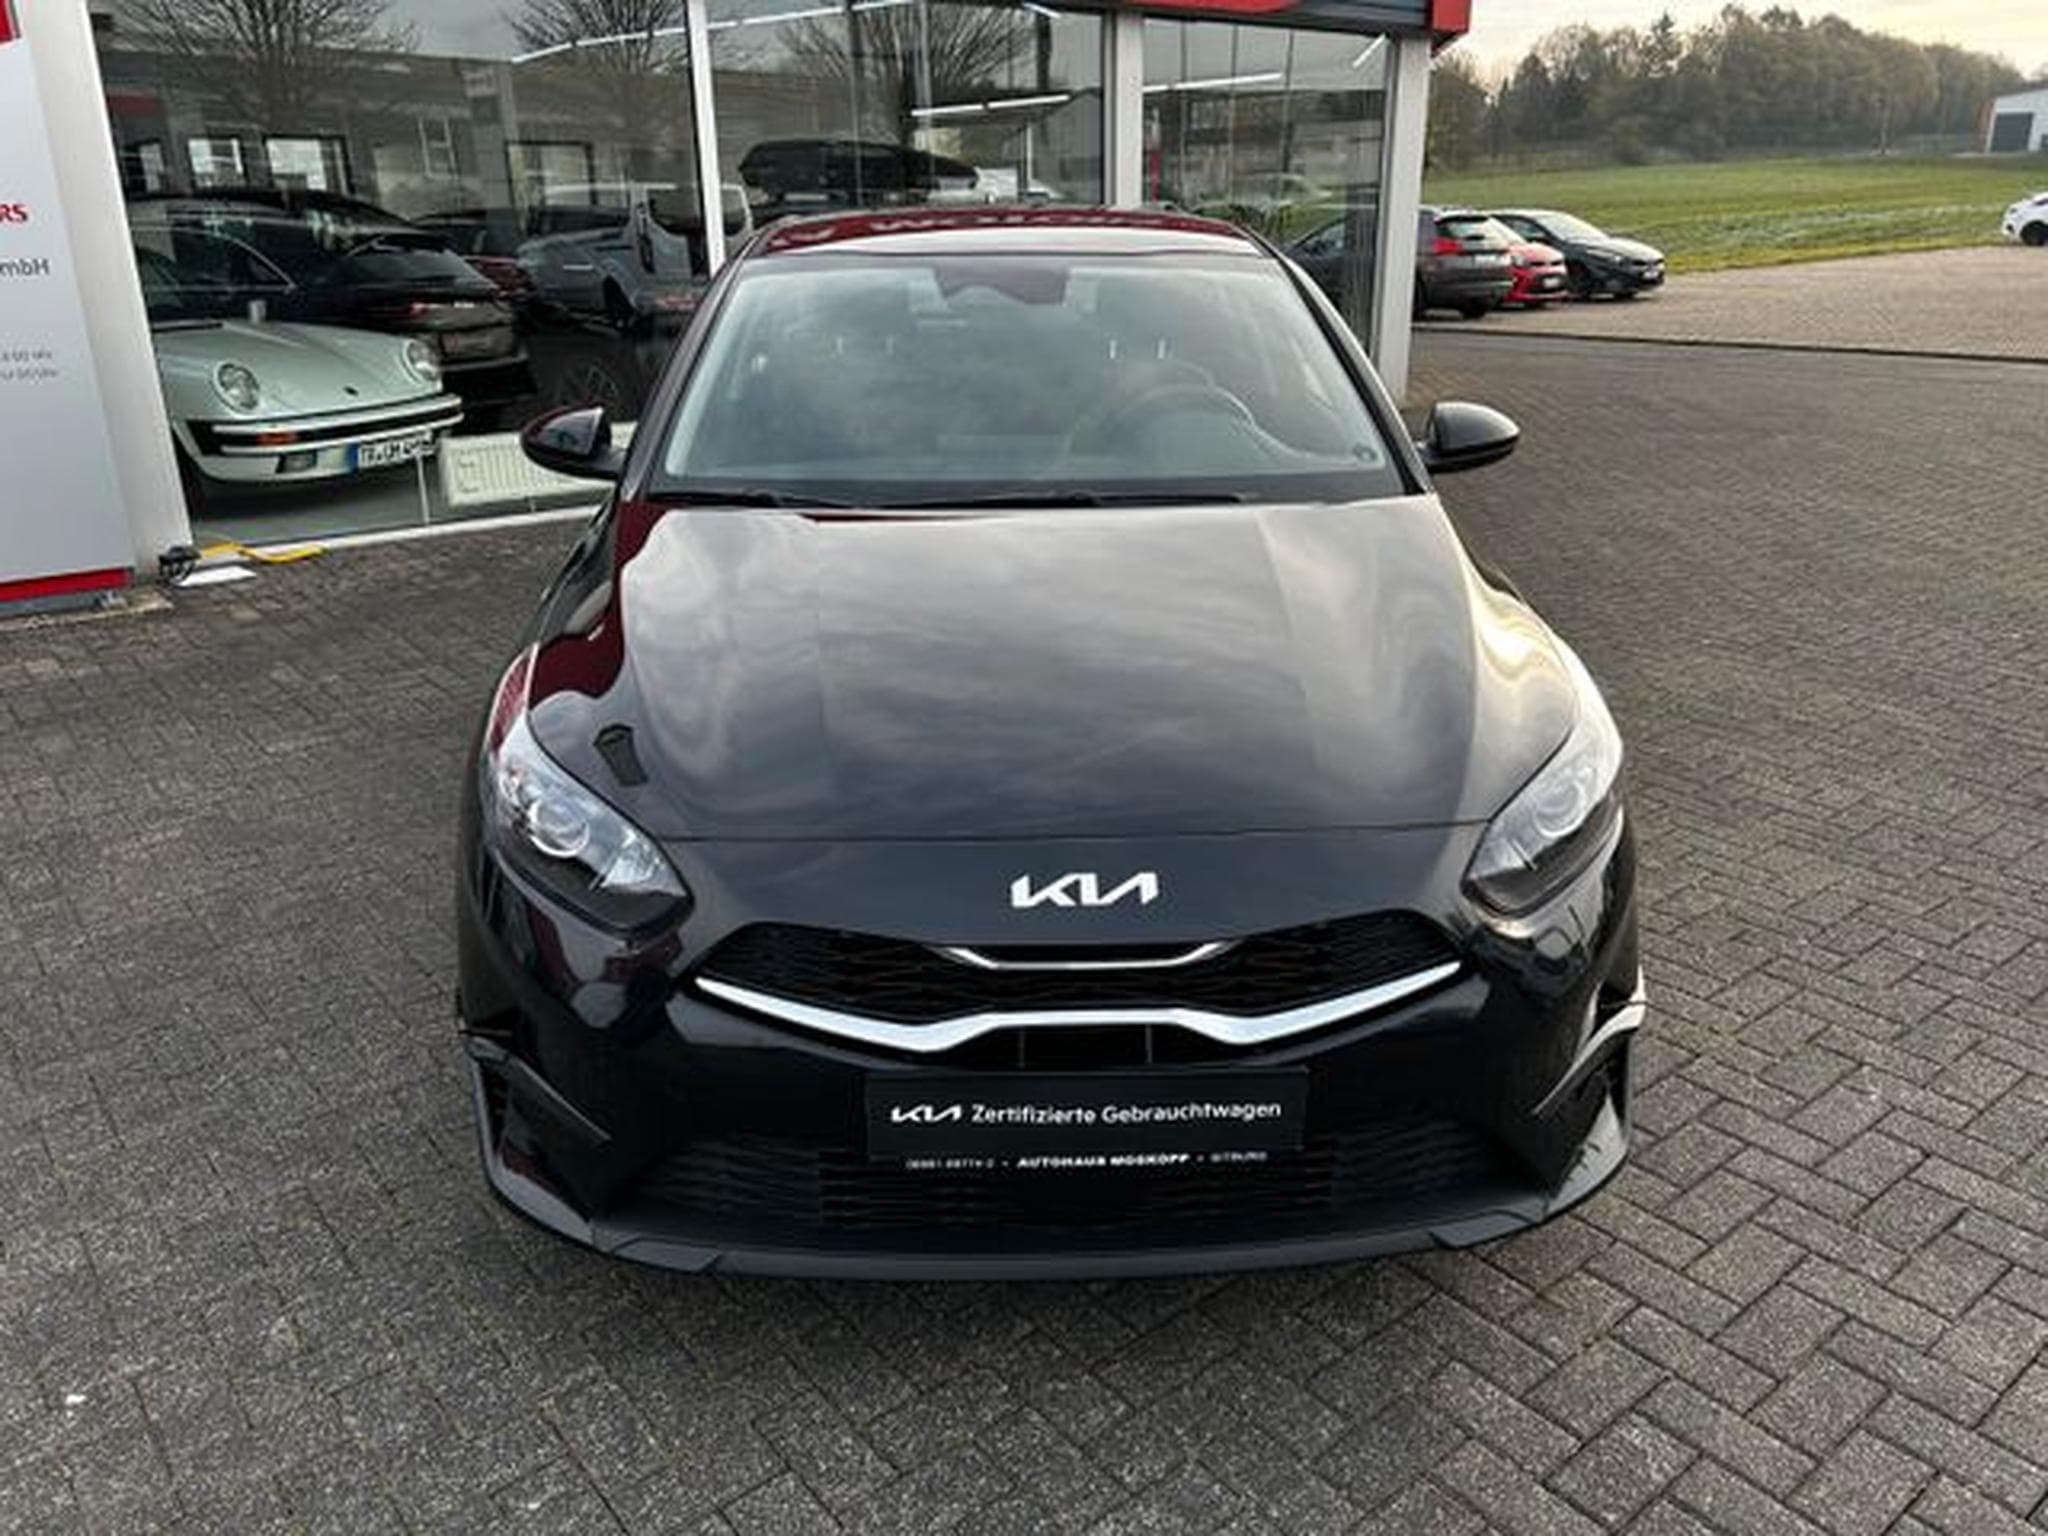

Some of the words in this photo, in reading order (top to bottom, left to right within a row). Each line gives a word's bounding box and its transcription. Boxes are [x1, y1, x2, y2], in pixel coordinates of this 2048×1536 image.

[1011, 871, 1159, 908] KIA
[891, 1104, 963, 1122] KIA
[971, 1103, 1097, 1124] Zertifizierte
[1101, 1101, 1282, 1124] Gebrauchtwagen
[1017, 1155, 1106, 1169] AUTOHAUS
